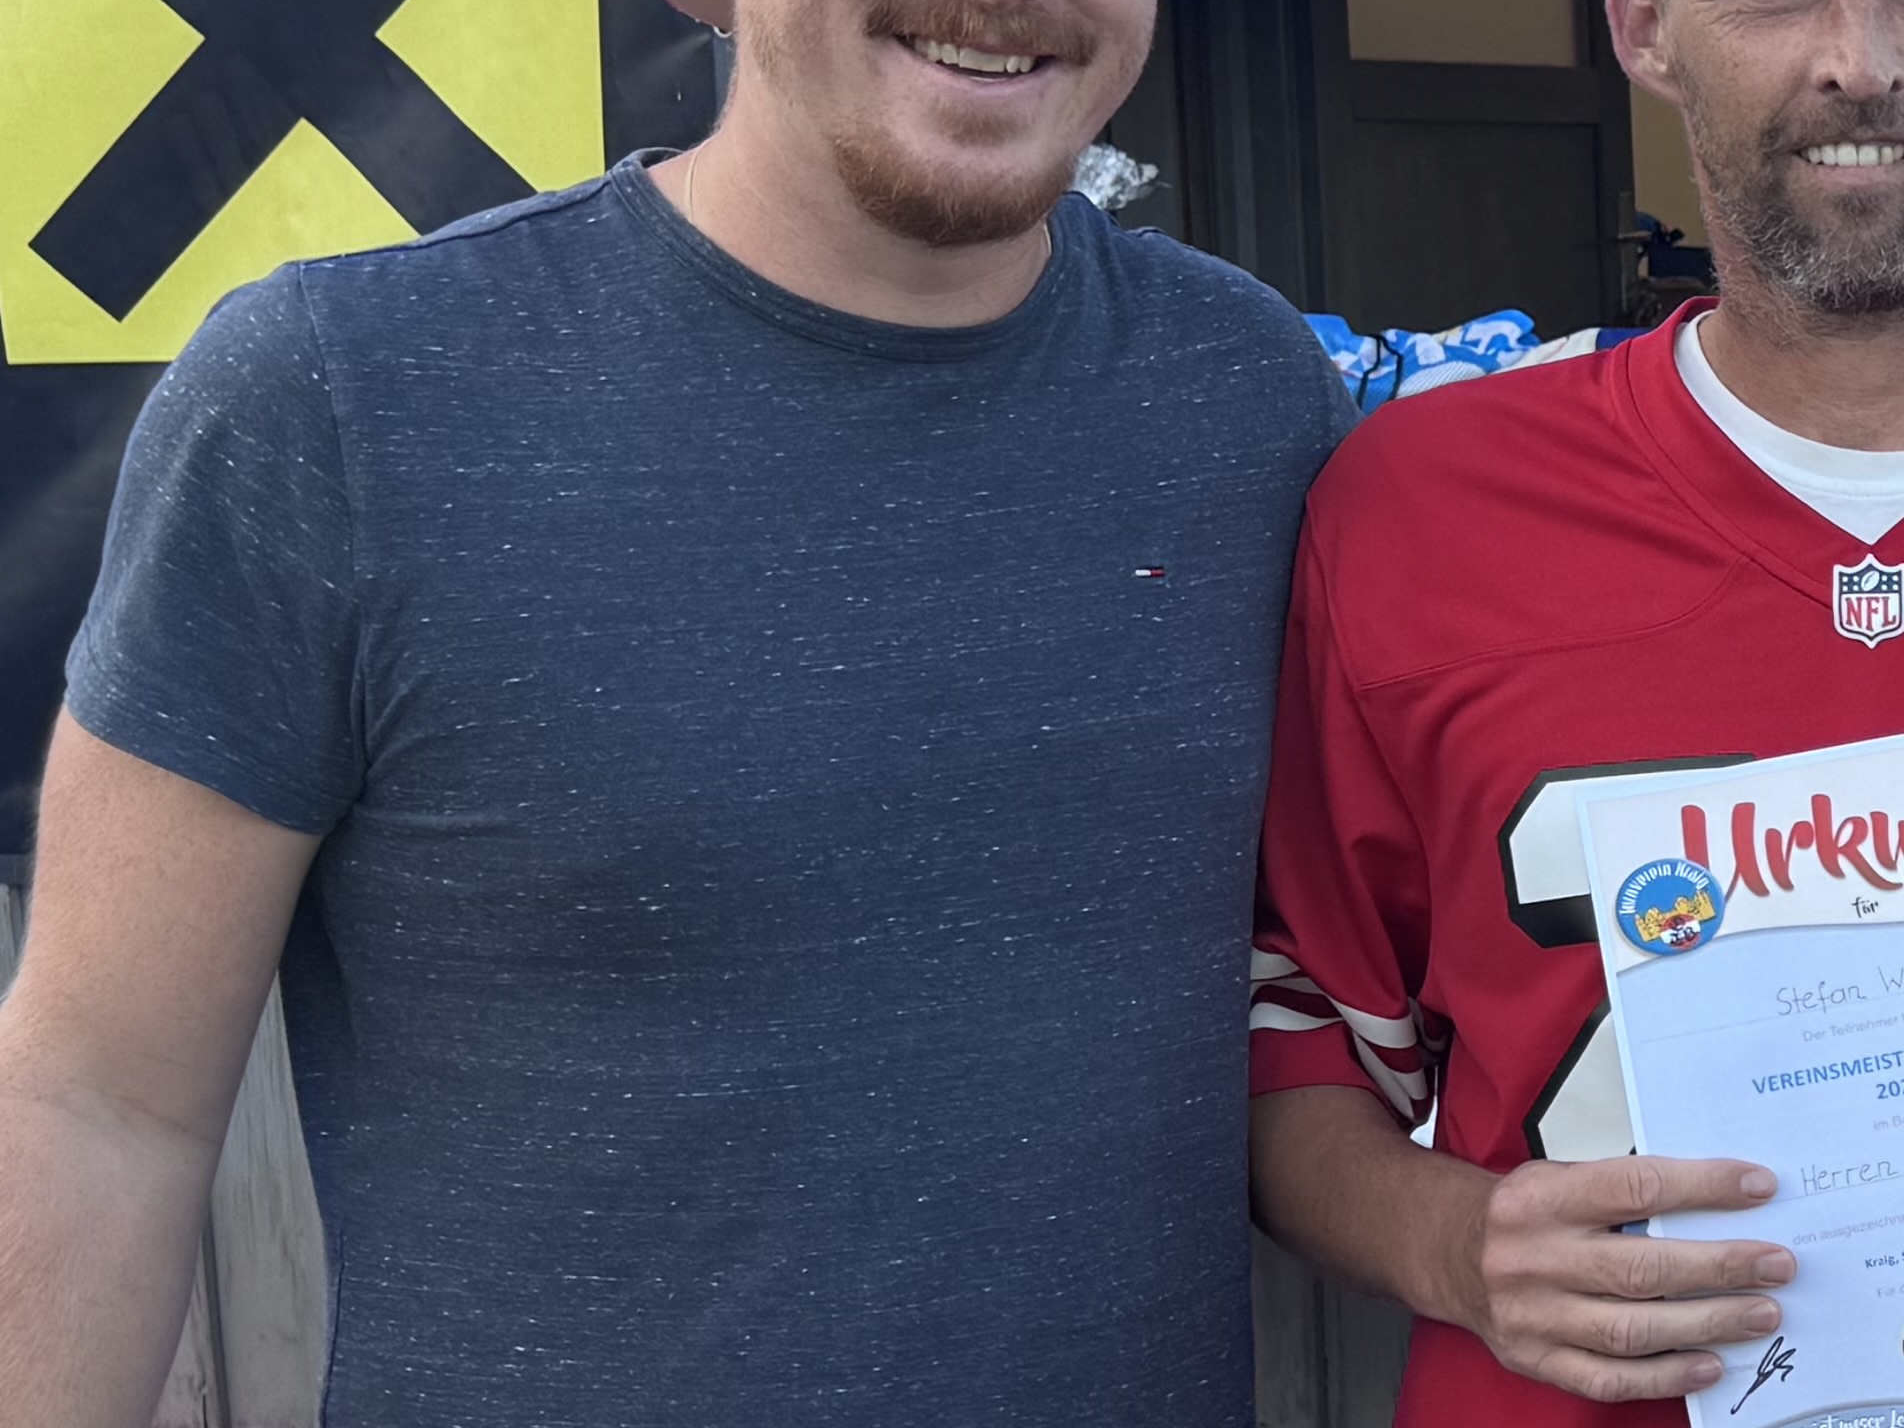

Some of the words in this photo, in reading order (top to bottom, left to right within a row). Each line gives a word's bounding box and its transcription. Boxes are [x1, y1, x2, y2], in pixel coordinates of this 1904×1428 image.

[1845, 596, 1897, 632] NFL
[1851, 896, 1879, 918] für
[1775, 980, 1868, 1016] Stefan
[1802, 1030, 1826, 1043] Der
[1829, 1015, 1899, 1038] Teilnehmer
[1800, 1160, 1899, 1197] Herren
[1865, 1251, 1899, 1269] Kraig,
